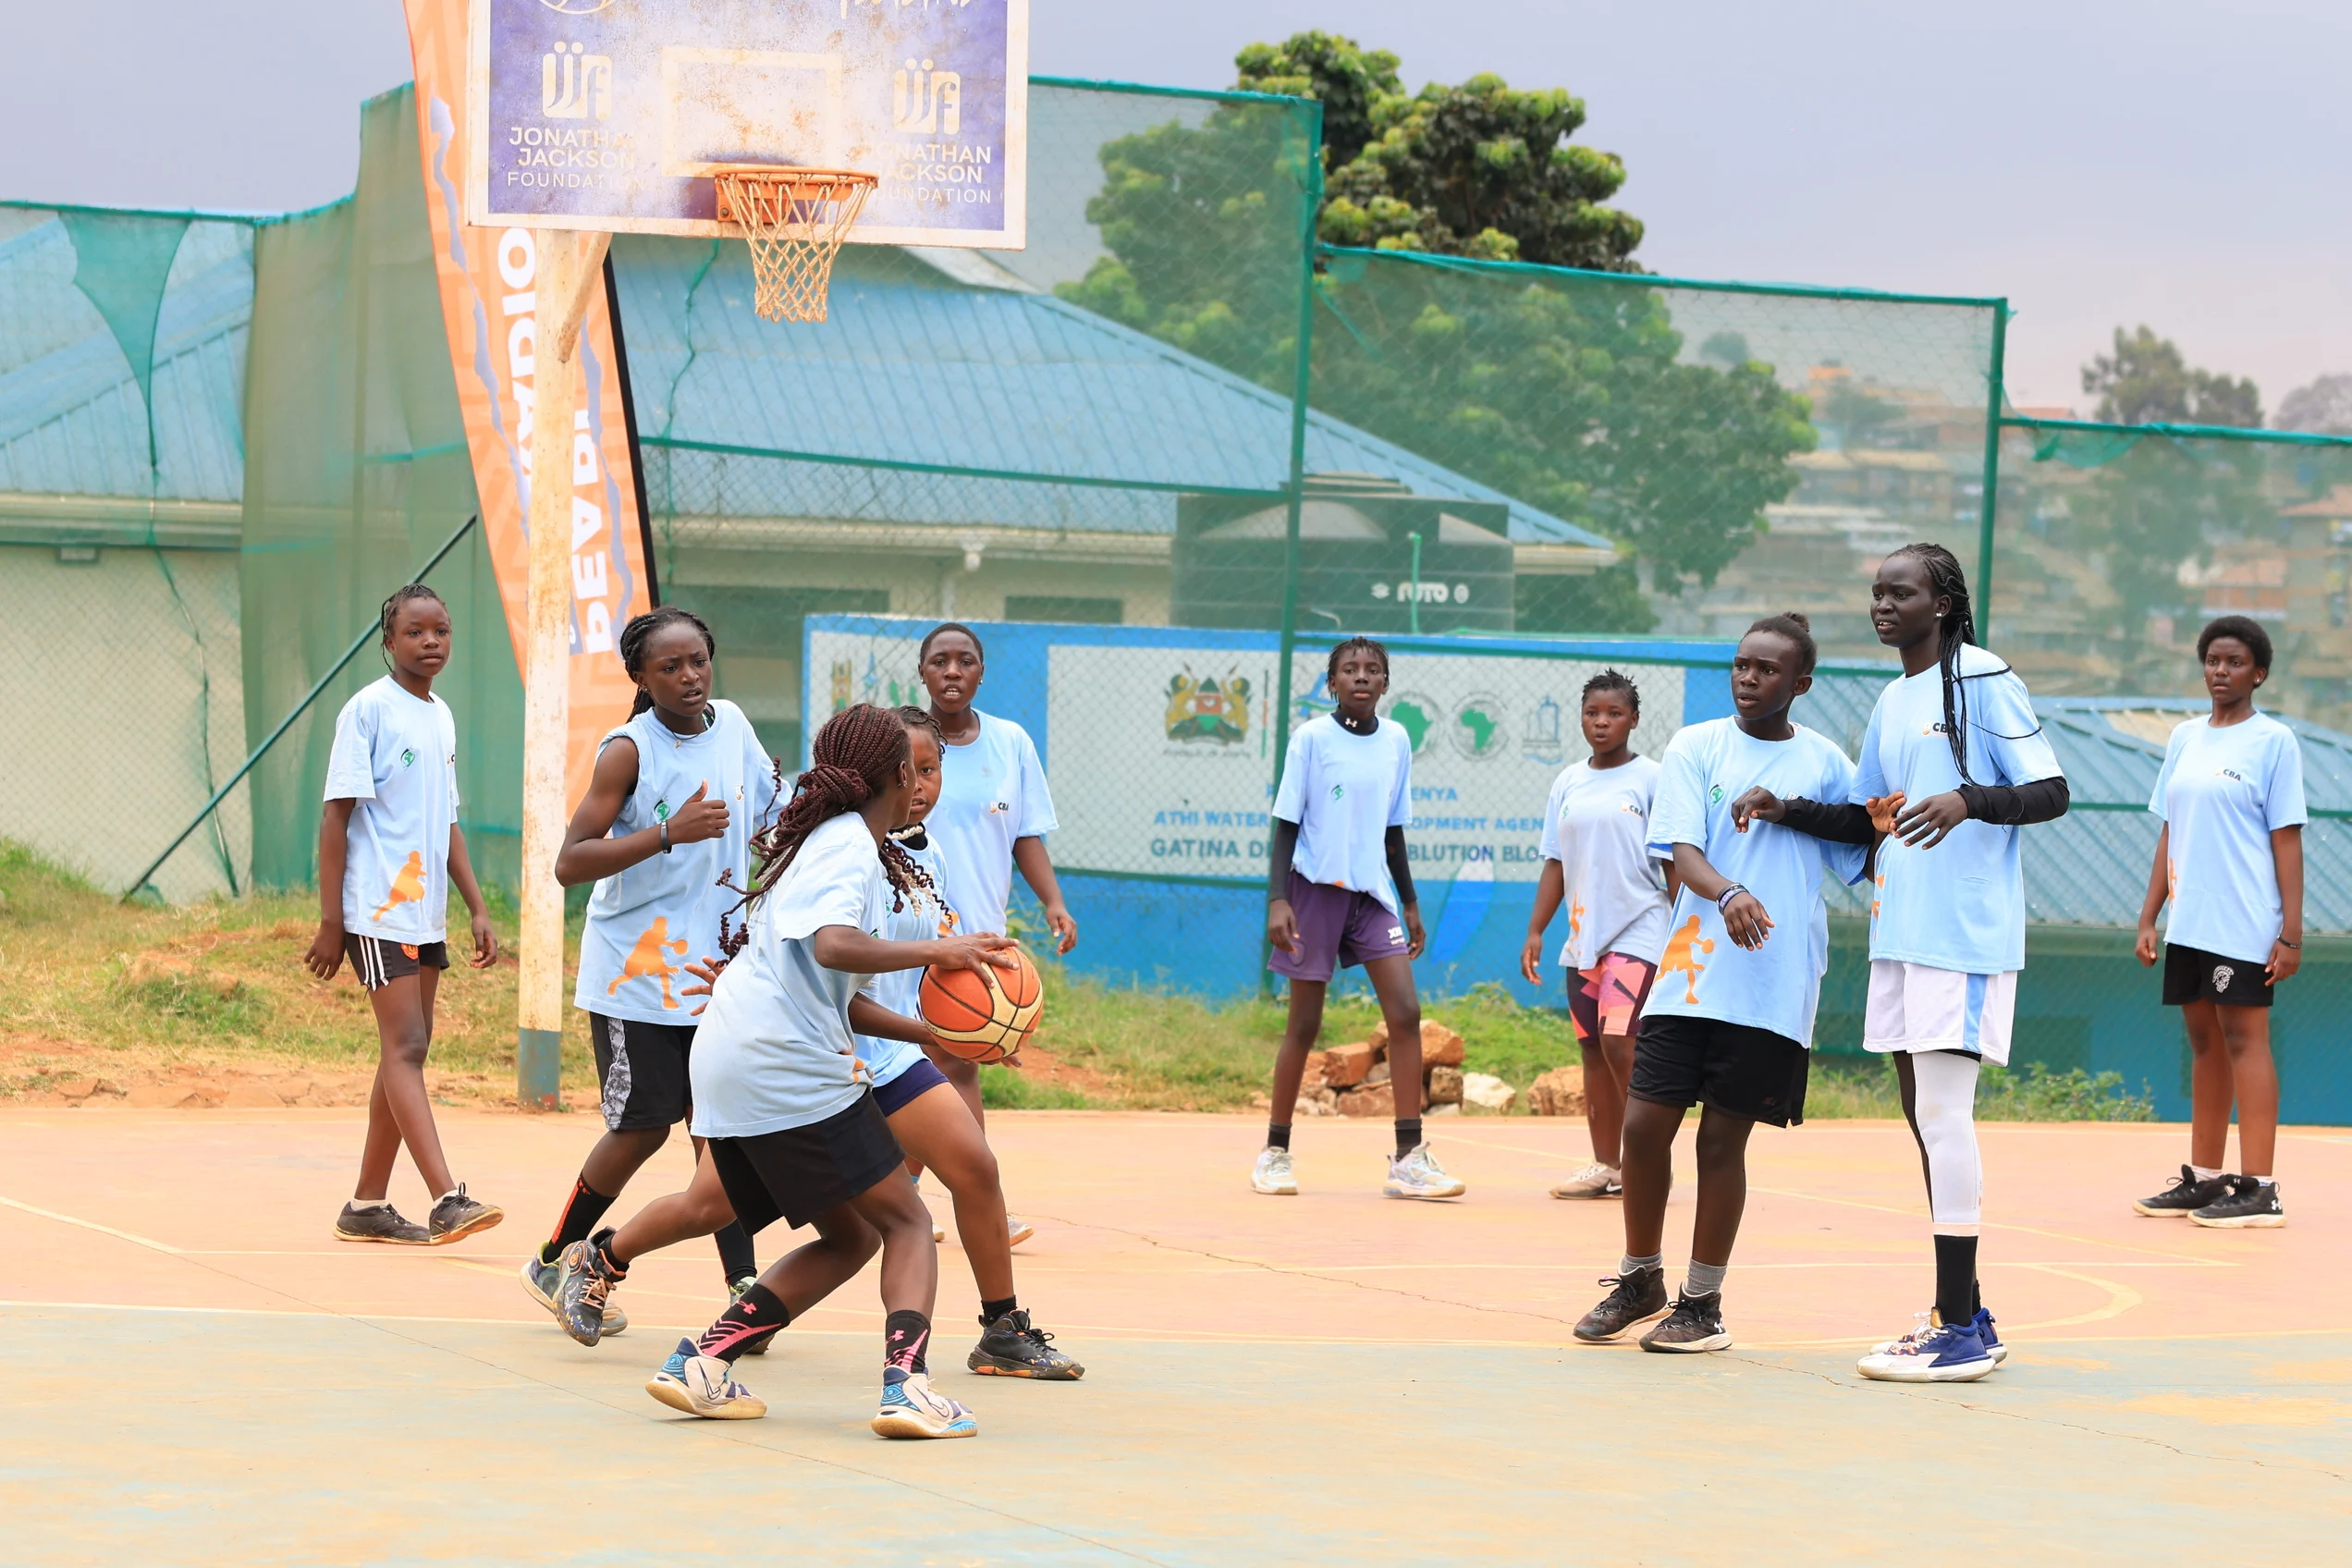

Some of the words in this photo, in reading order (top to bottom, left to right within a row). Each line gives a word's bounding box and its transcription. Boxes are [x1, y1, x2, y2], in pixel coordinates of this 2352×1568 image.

[518, 148, 635, 169] JACKSON
[867, 141, 991, 165] ONATHAN
[508, 171, 646, 190] FOUNDATION
[874, 187, 992, 204] OUNDATION
[1932, 722, 1949, 734] CB
[2223, 768, 2242, 782] CBA
[1410, 786, 1458, 802] ENYA
[1154, 810, 1199, 826] ATHI
[1204, 811, 1269, 827] WATER
[1494, 816, 1545, 832] AGEN
[1150, 838, 1241, 858] GATINA
[1407, 843, 1494, 862] BLUTION
[1501, 845, 1546, 862] BLO
